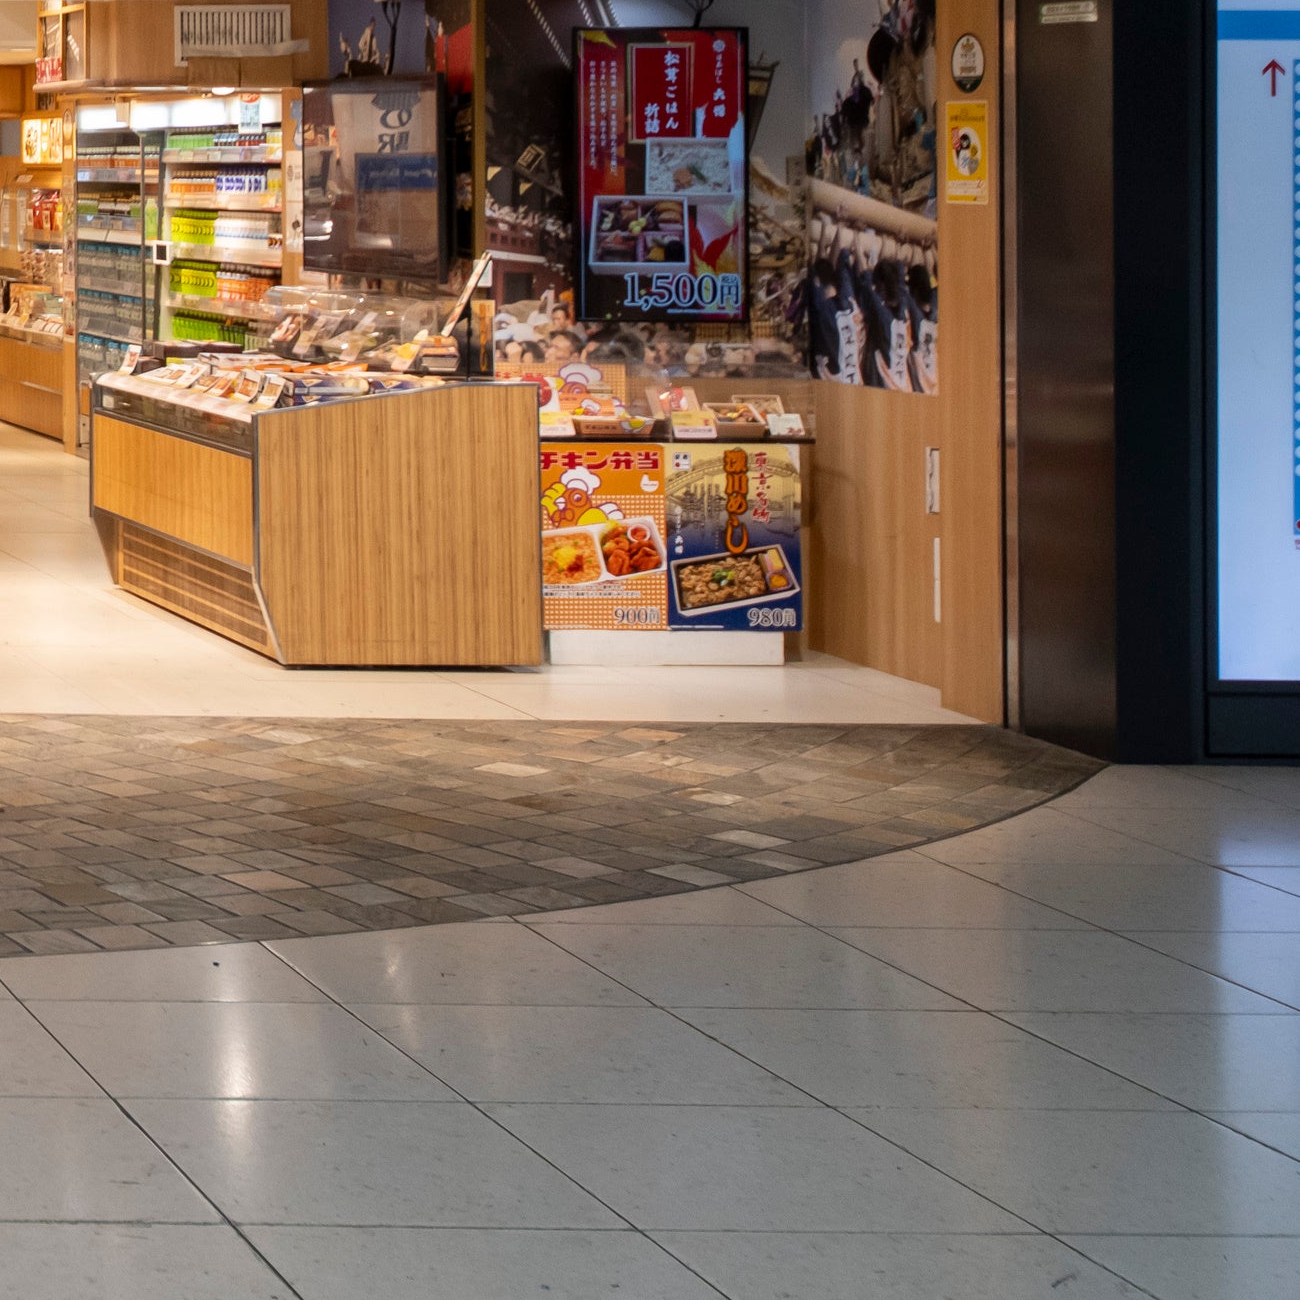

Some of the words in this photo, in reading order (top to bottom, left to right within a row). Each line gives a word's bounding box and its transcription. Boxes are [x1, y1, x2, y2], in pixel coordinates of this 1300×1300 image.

[664, 50, 681, 130] 松茸ごはん
[644, 102, 660, 134] 折詰
[623, 271, 742, 312] 1,500円
[540, 451, 660, 471] チキン弁当
[722, 448, 749, 555] 深川めし
[752, 451, 774, 525] 東京名物
[747, 607, 797, 627] 980円
